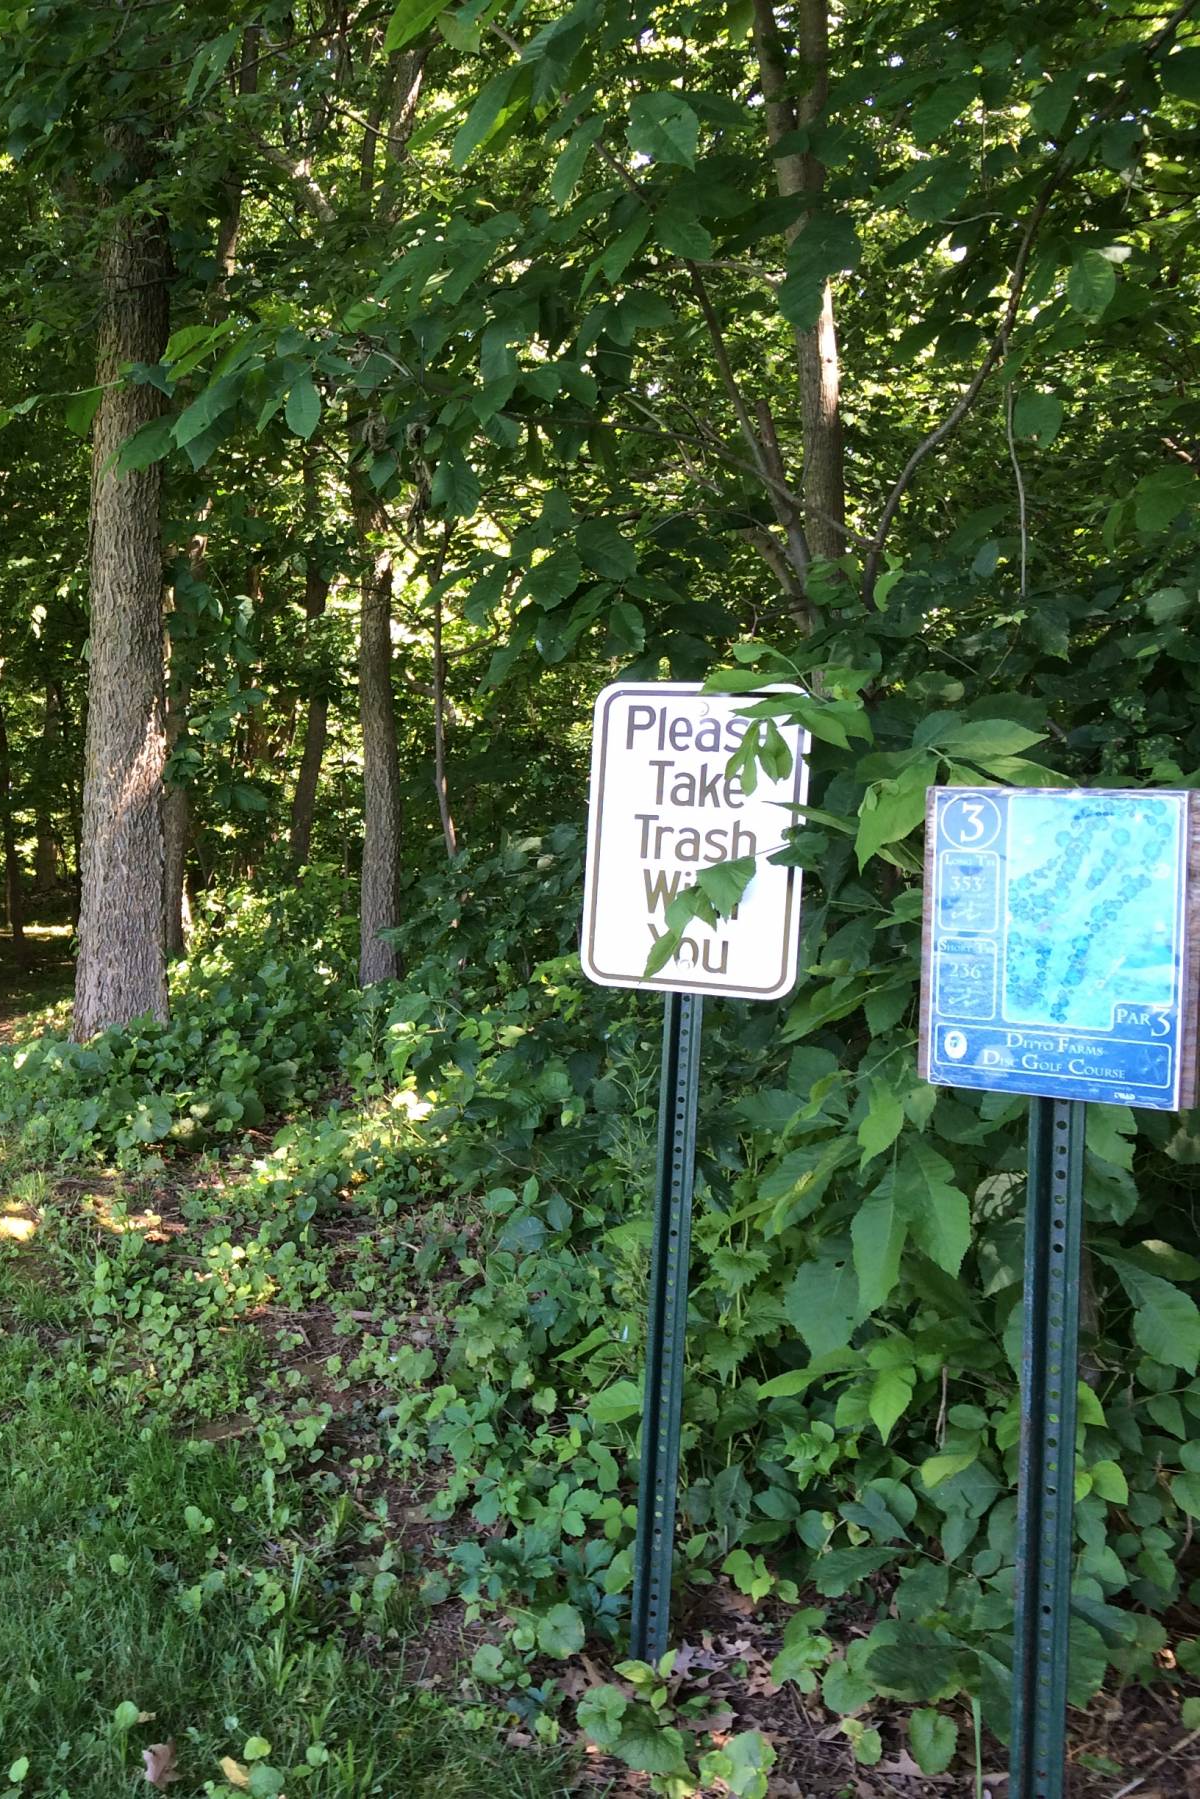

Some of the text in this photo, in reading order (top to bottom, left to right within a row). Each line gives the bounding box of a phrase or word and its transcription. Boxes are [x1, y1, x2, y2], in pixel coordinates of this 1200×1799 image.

[626, 705, 767, 753] Pleas
[649, 760, 745, 809] Take
[634, 814, 757, 863] Trash
[960, 801, 985, 843] 3
[1115, 1007, 1171, 1037] PAR 3
[1068, 1059, 1126, 1079] COURSE
